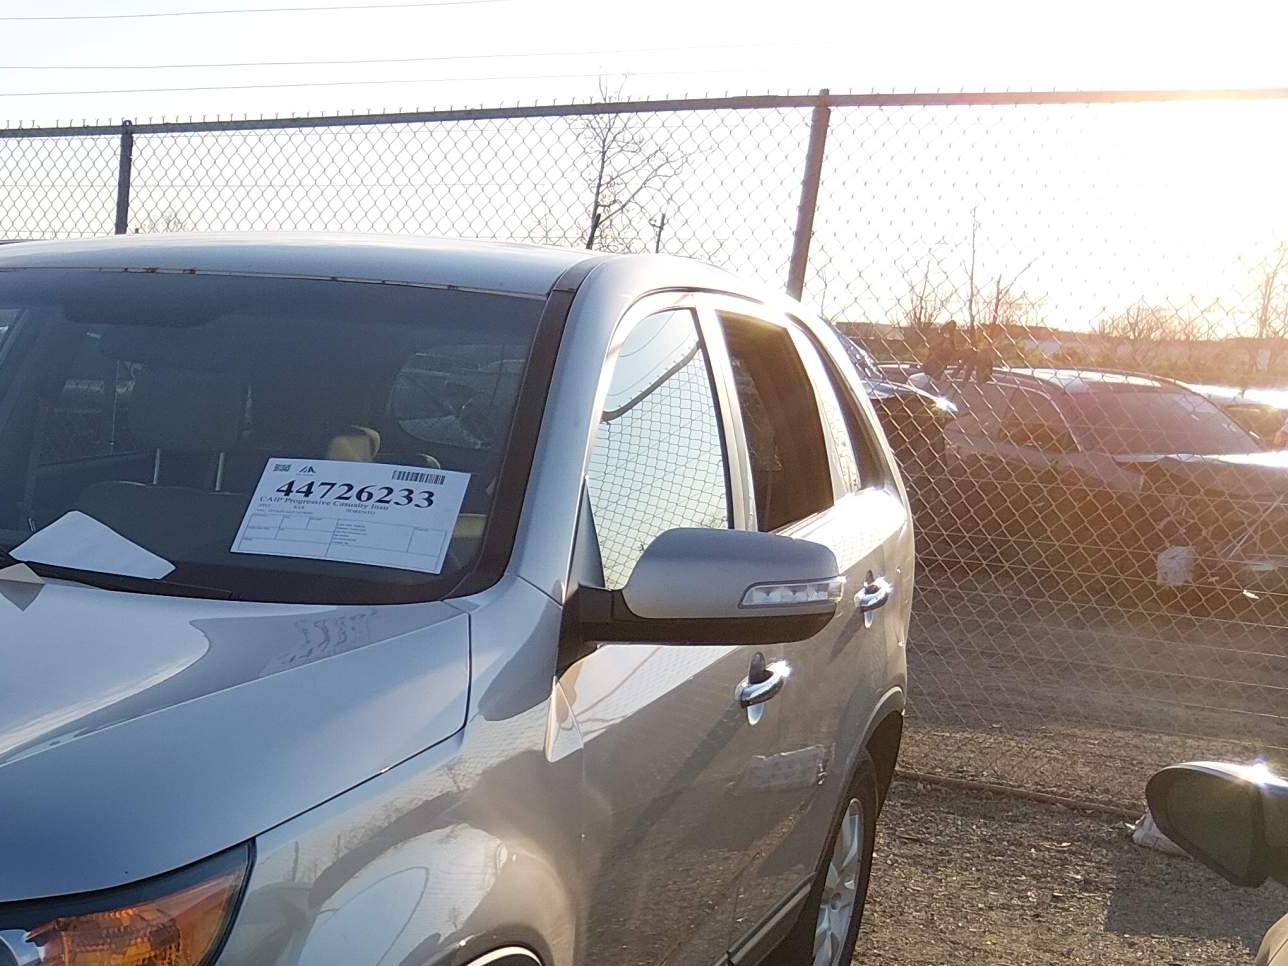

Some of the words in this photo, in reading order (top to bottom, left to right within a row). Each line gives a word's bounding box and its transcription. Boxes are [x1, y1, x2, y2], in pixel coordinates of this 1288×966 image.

[275, 479, 435, 509] 44726233
[285, 497, 331, 507] Progressive
[333, 500, 369, 510] Casualty
